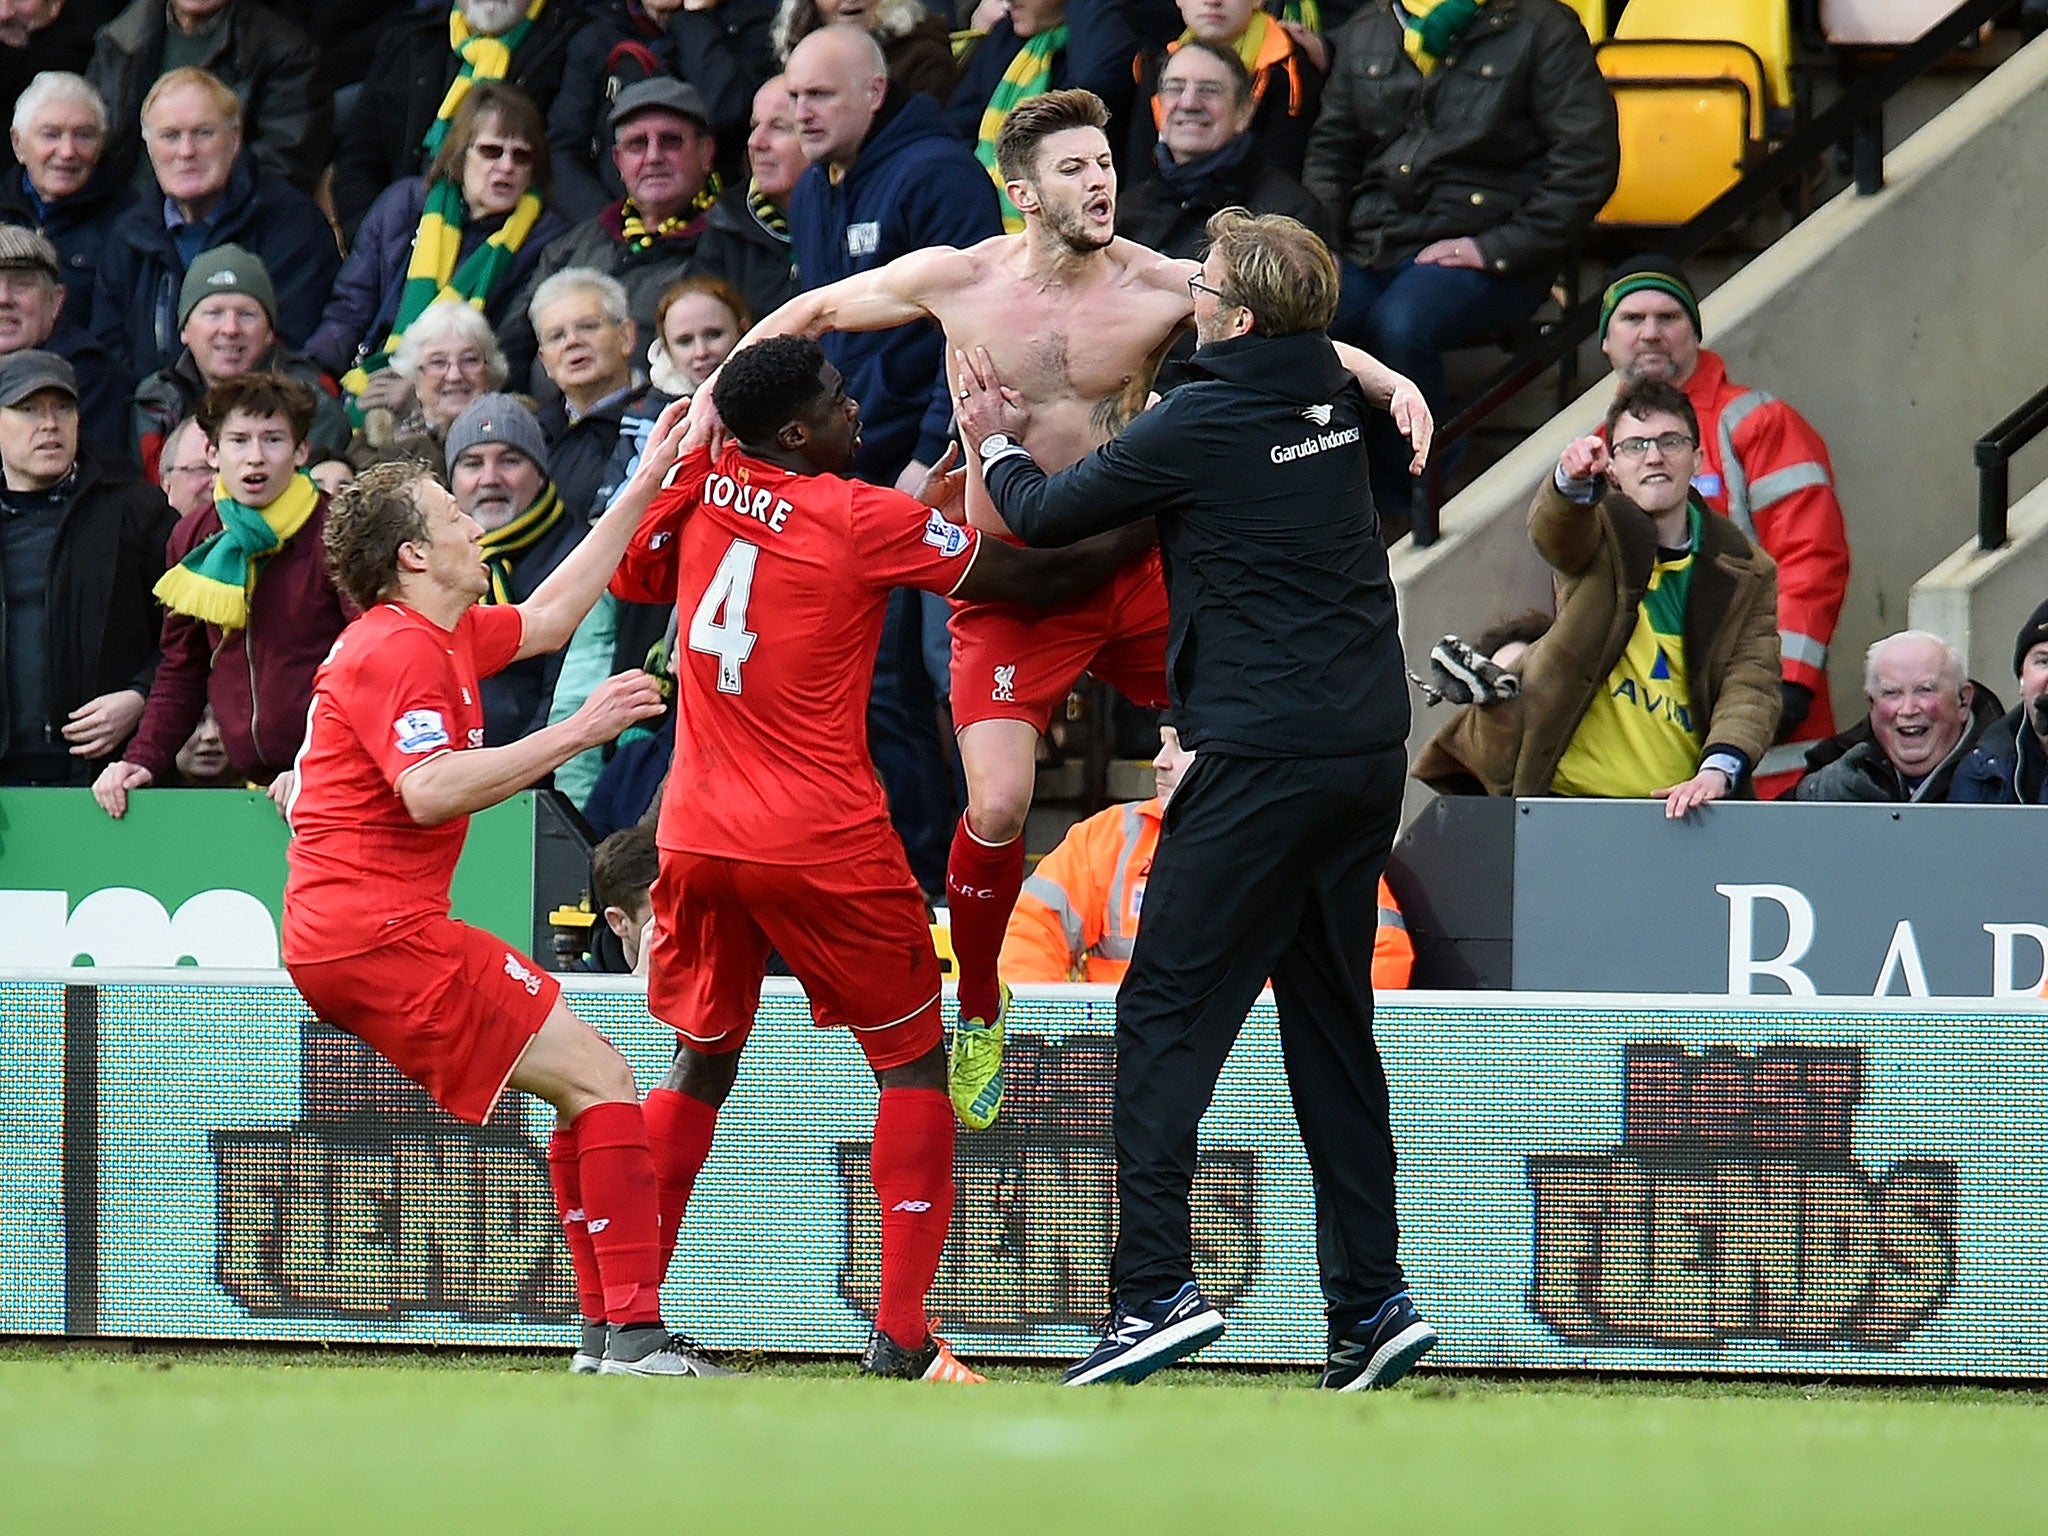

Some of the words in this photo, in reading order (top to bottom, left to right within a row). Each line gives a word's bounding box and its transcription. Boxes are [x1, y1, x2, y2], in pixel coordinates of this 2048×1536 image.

[1270, 437, 1320, 464] Garuda
[703, 472, 794, 533] TOURE
[688, 537, 759, 695] 4
